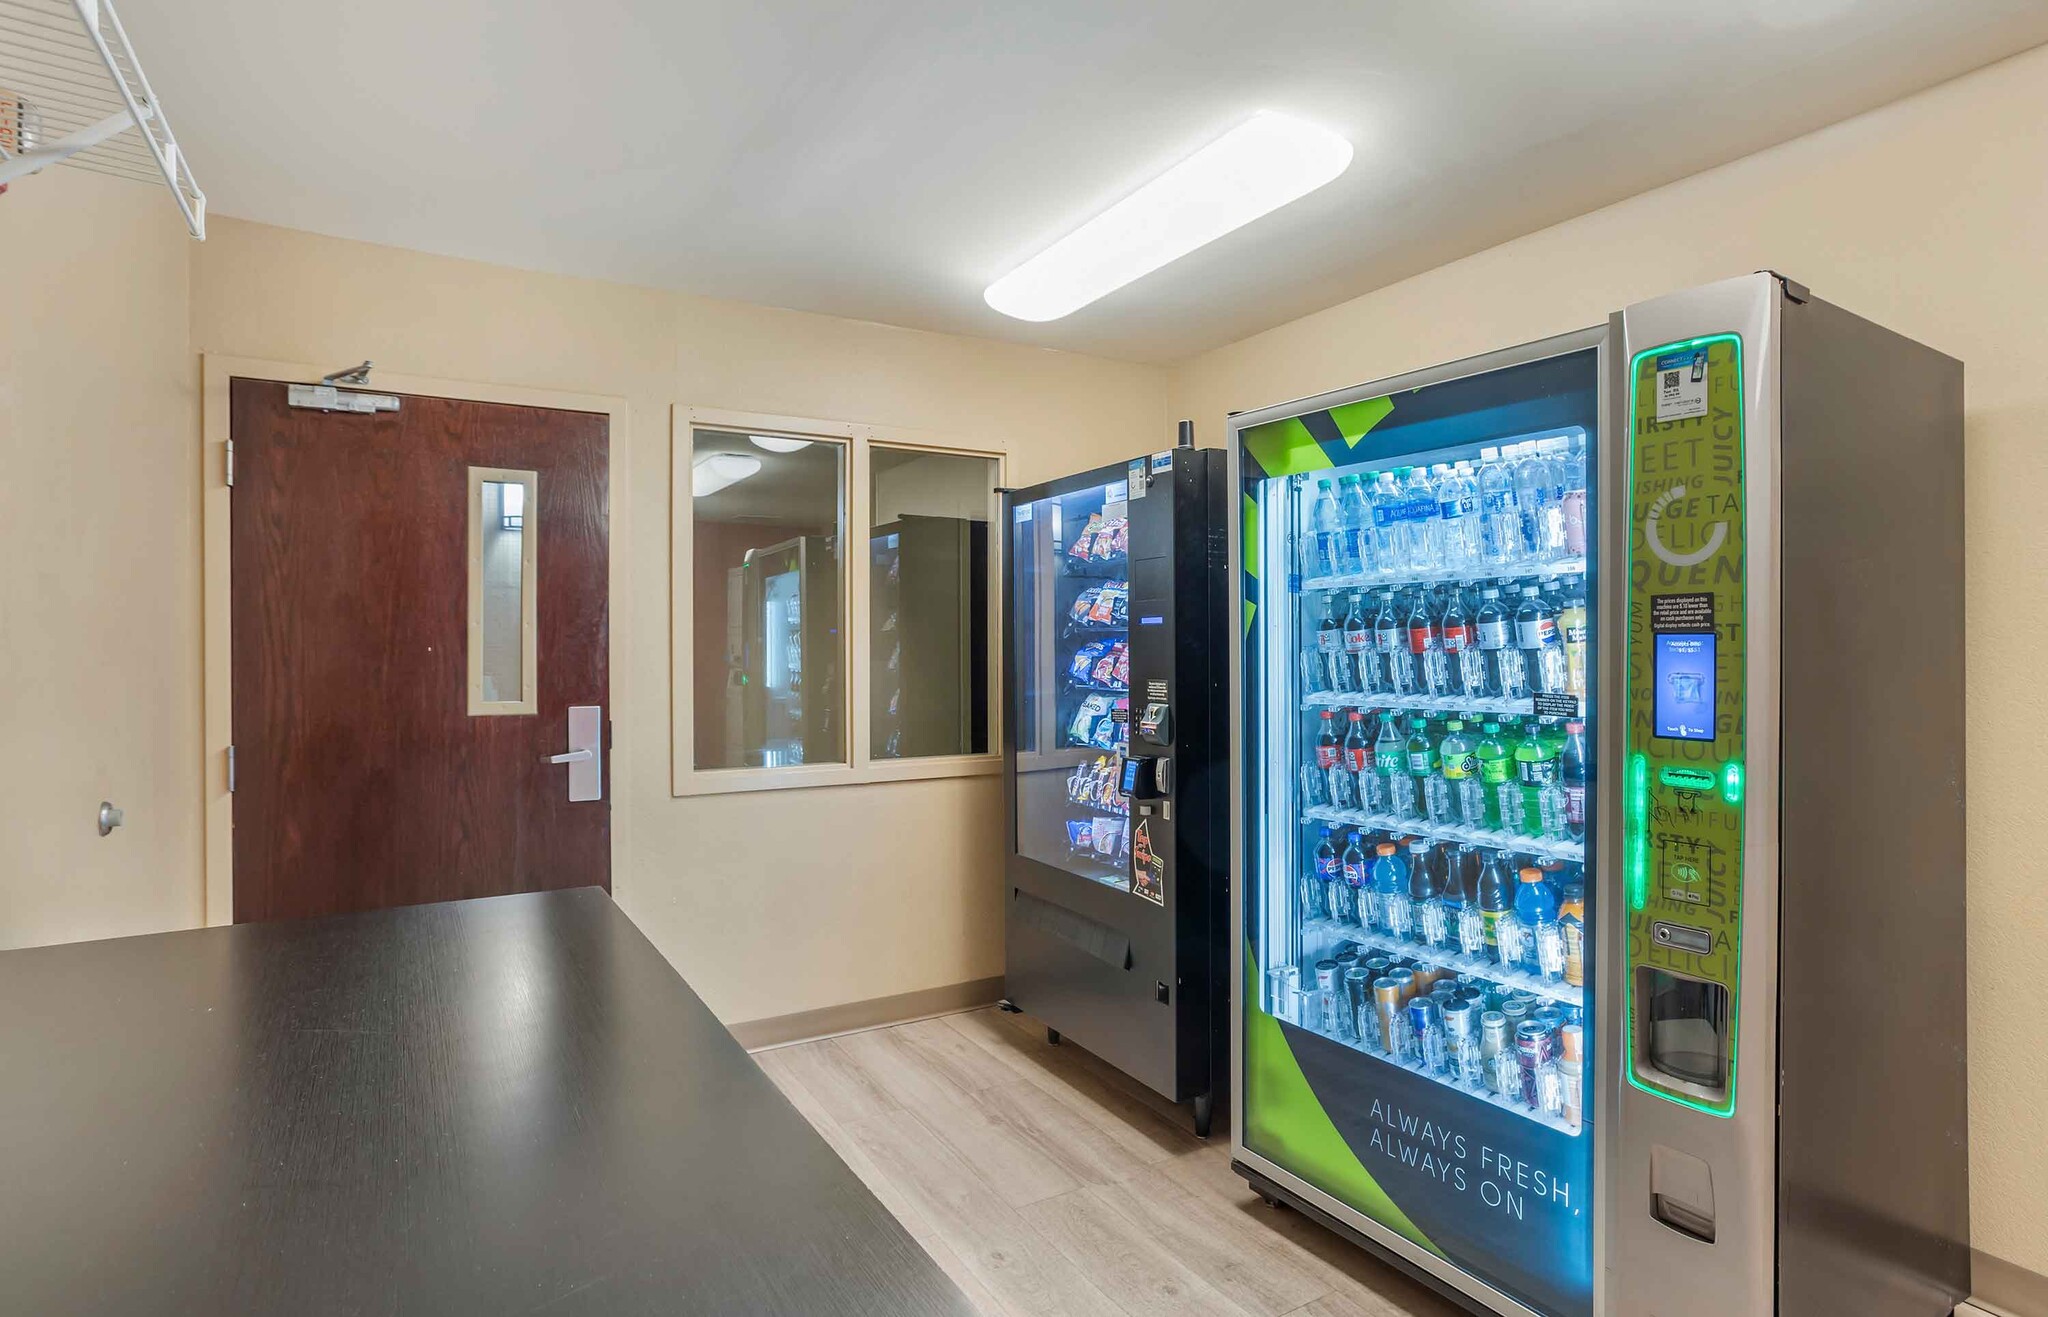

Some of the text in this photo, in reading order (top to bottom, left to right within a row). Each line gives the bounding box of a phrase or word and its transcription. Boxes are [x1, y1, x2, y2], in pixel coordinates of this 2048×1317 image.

[1712, 407, 1734, 487] JUICY
[1346, 631, 1371, 644] Coke
[1370, 1098, 1580, 1216] ALWAYS FRESH,
[1370, 1128, 1523, 1221] ALWAYS ON
